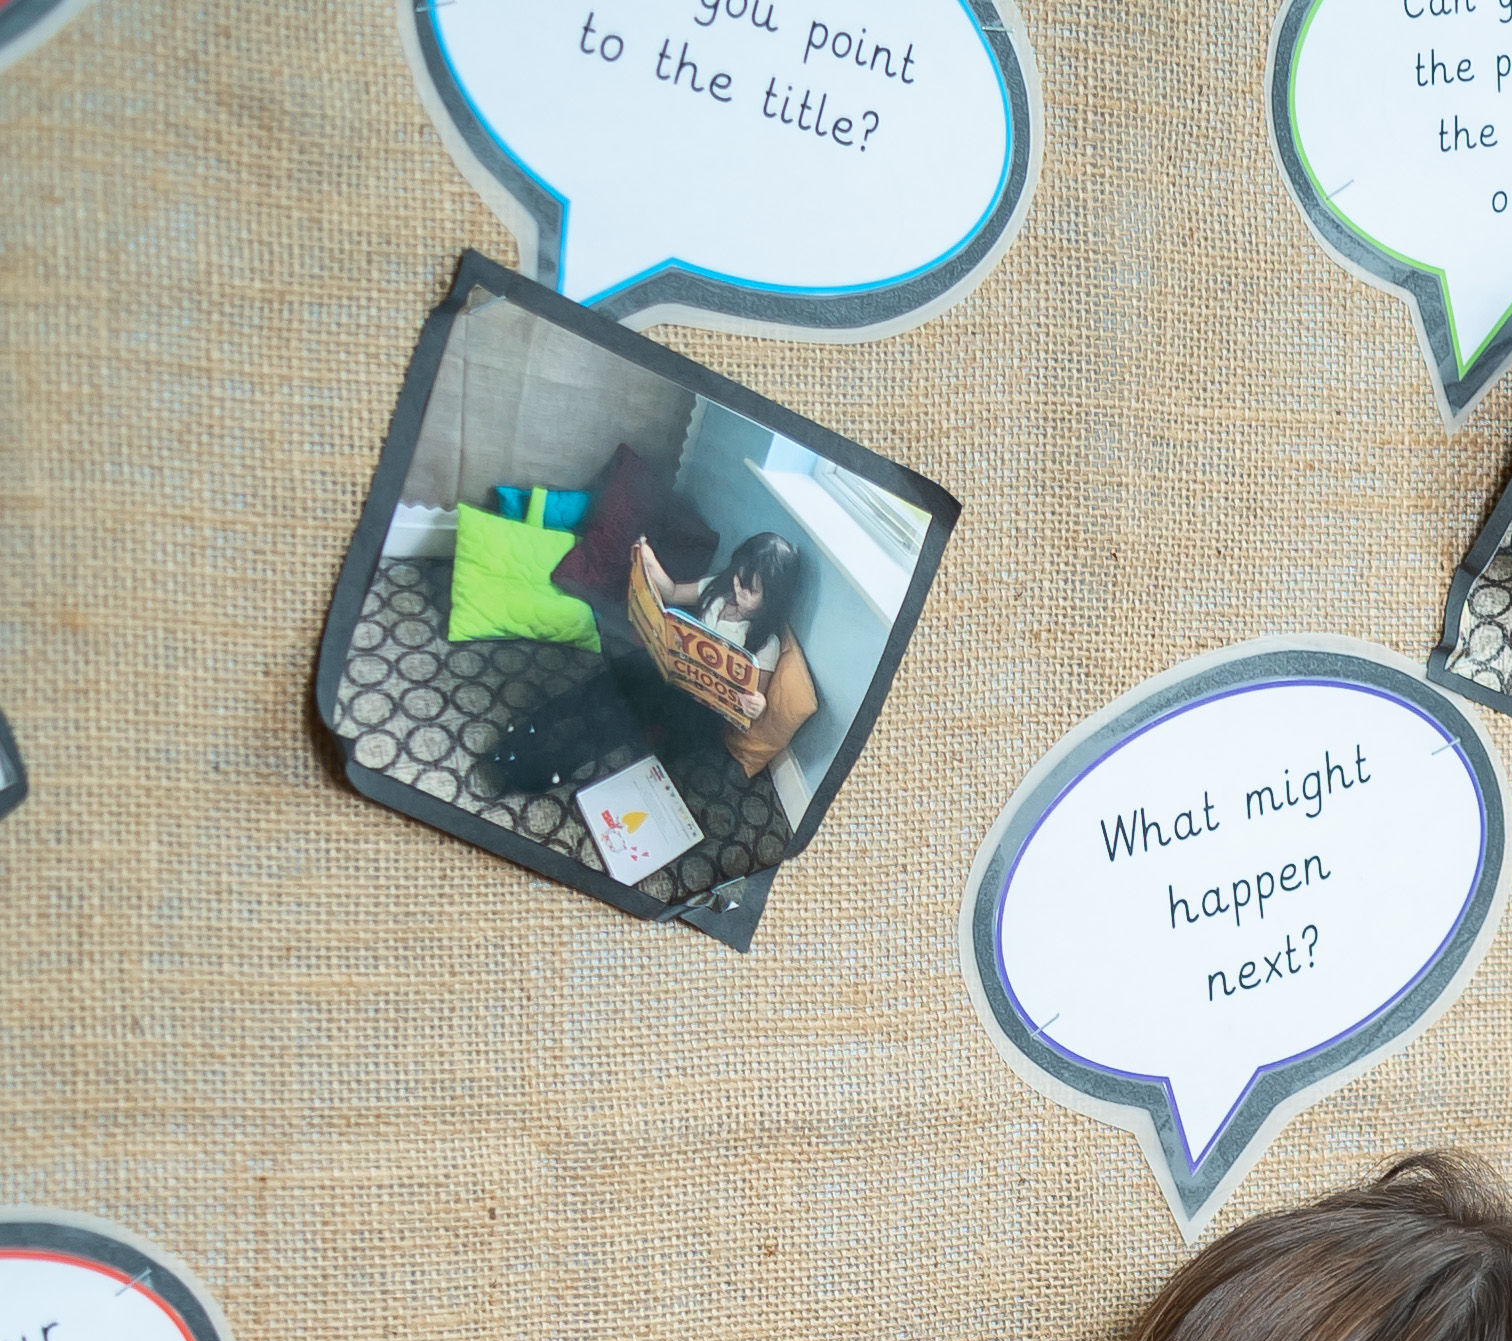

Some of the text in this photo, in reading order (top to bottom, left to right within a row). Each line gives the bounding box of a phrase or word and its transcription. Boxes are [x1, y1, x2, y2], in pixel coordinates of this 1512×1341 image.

[579, 12, 880, 153] to the title?
[803, 19, 916, 85] point
[1415, 52, 1475, 87] the
[1439, 116, 1499, 152] the
[671, 625, 753, 686] YOU
[1100, 744, 1372, 862] What might
[1168, 854, 1332, 929] happen
[1207, 924, 1320, 1001] next?
